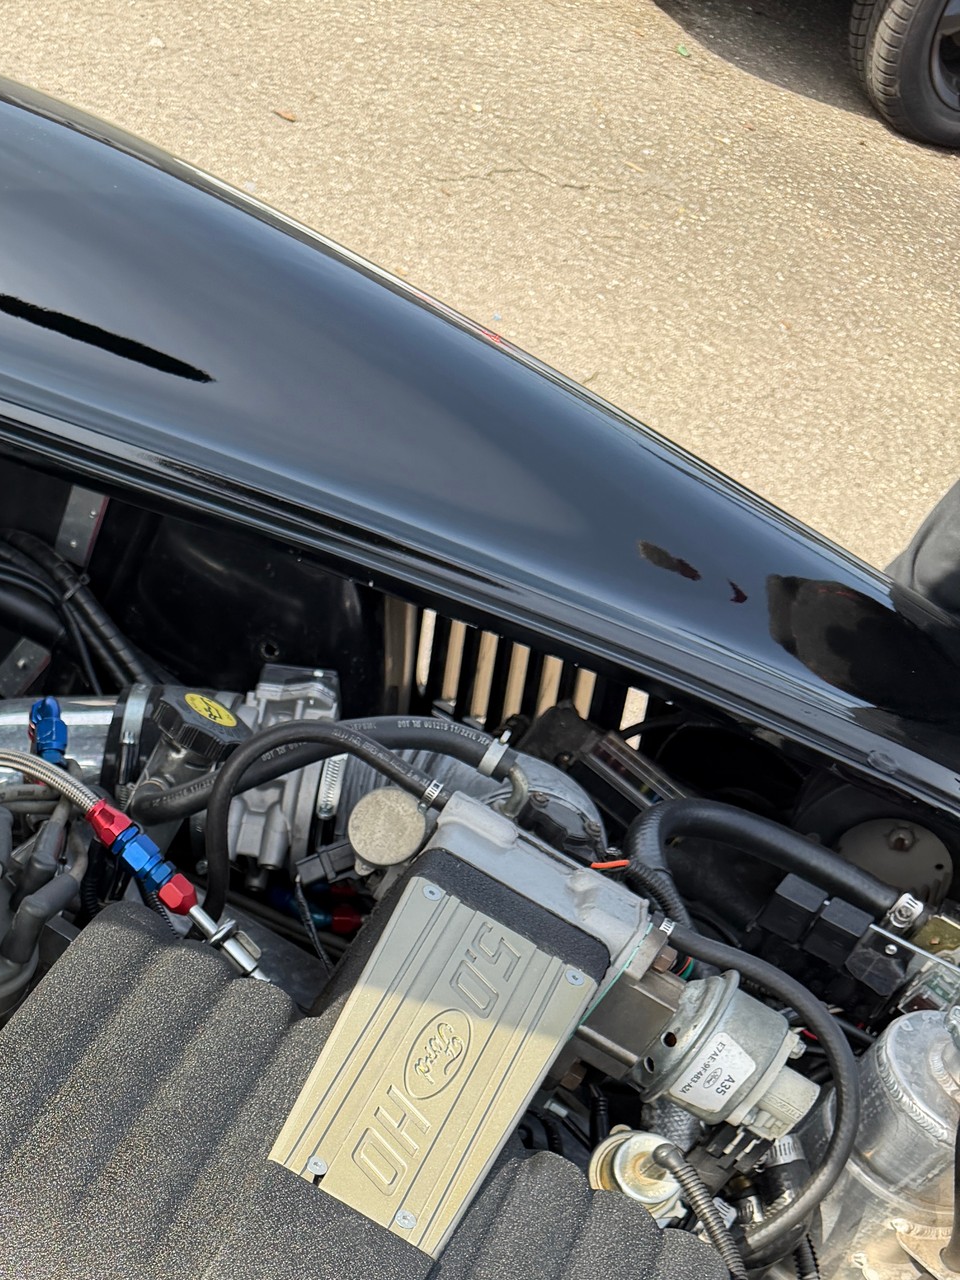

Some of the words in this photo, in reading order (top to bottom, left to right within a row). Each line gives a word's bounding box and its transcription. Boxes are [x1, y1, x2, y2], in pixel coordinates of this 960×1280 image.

[411, 1019, 468, 1088] Ford
[715, 1074, 736, 1096] A35
[351, 1084, 432, 1197] HO
